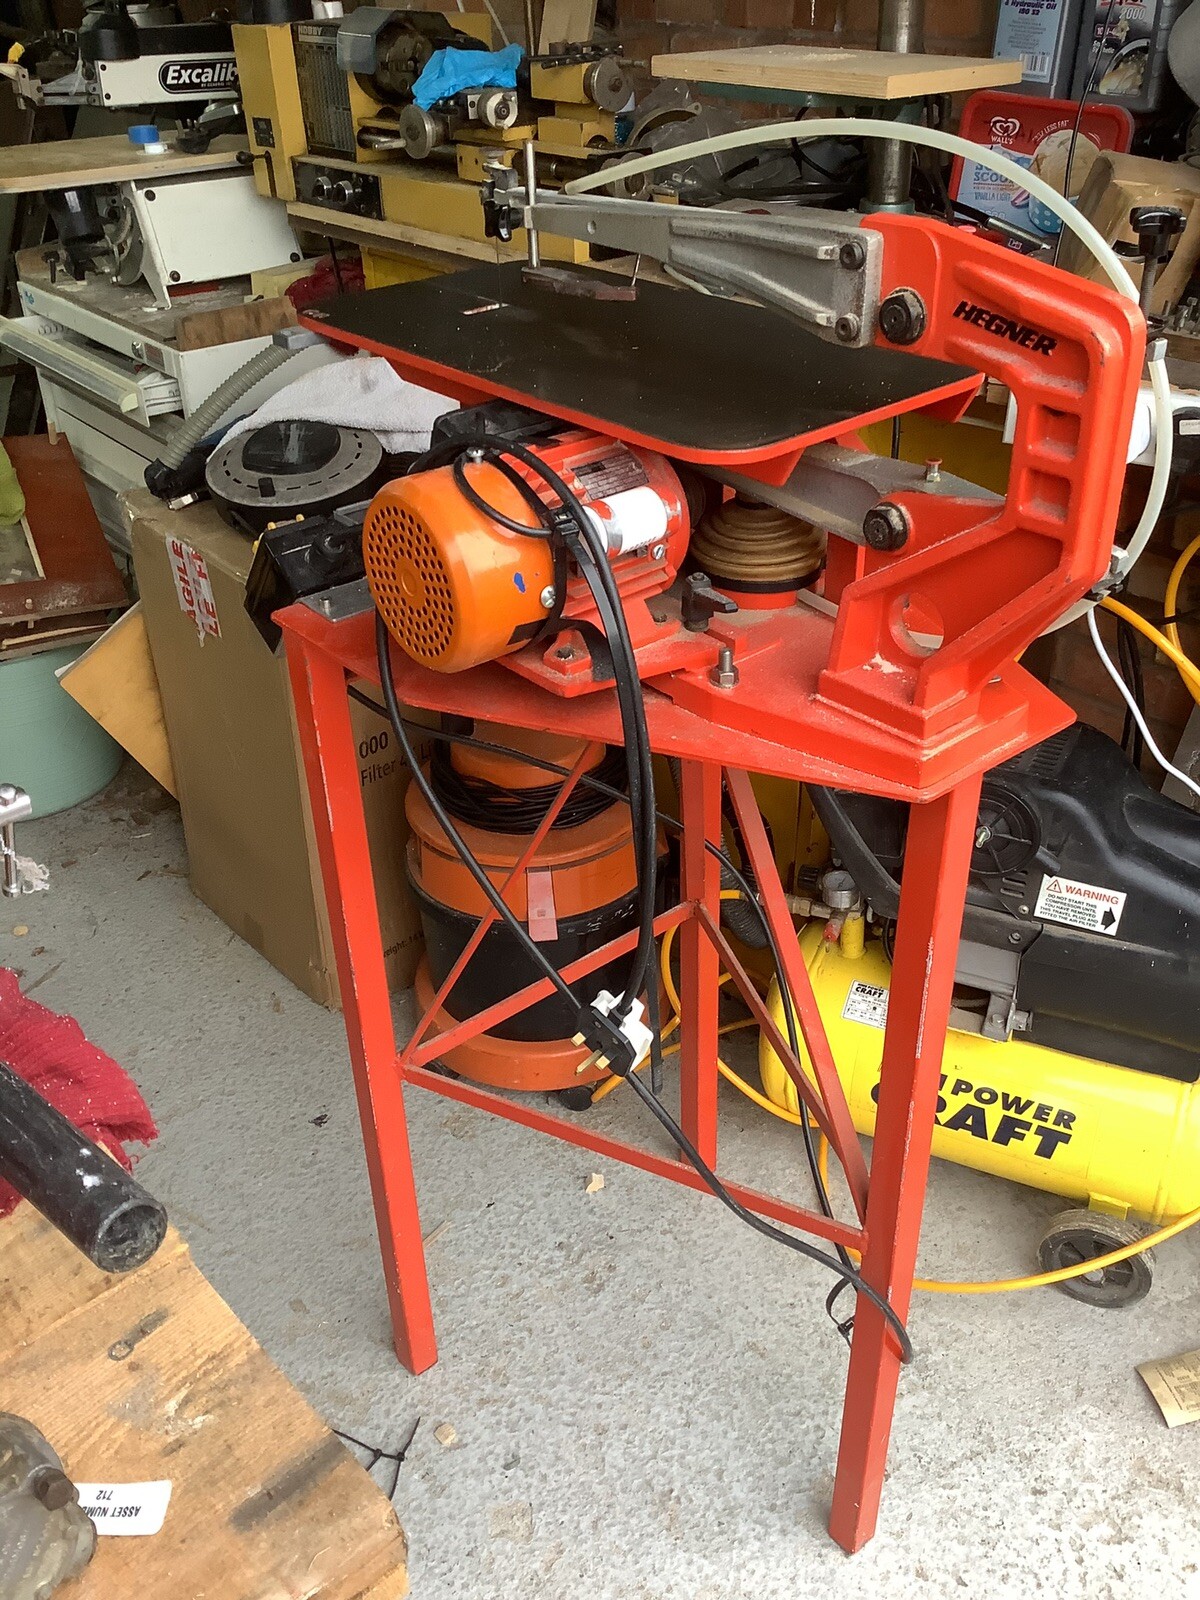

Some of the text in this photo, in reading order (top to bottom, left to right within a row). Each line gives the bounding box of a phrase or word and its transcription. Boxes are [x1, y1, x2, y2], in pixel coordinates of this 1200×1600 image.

[1011, 0, 1044, 8] Hydraulic
[1119, 7, 1146, 19] 2000
[298, 25, 323, 36] HOBBY
[991, 135, 1014, 145] WALL'S
[973, 171, 1014, 184] SCOO
[974, 191, 996, 201] VANILLA
[952, 300, 1058, 357] HEGNER
[360, 760, 396, 787] Filter
[1065, 884, 1120, 905] WARNING
[1045, 897, 1081, 910] COMPRESSOR
[1068, 897, 1085, 905] START
[1052, 909, 1071, 917] TRAVEL
[1070, 909, 1096, 919] REMOVED
[1039, 911, 1058, 919] FITTED
[1078, 920, 1097, 928] FILTER
[855, 986, 884, 998] CRAFT
[950, 1078, 1077, 1131] POWER
[95, 1489, 114, 1501] 712
[109, 1505, 142, 1518] ASSET
